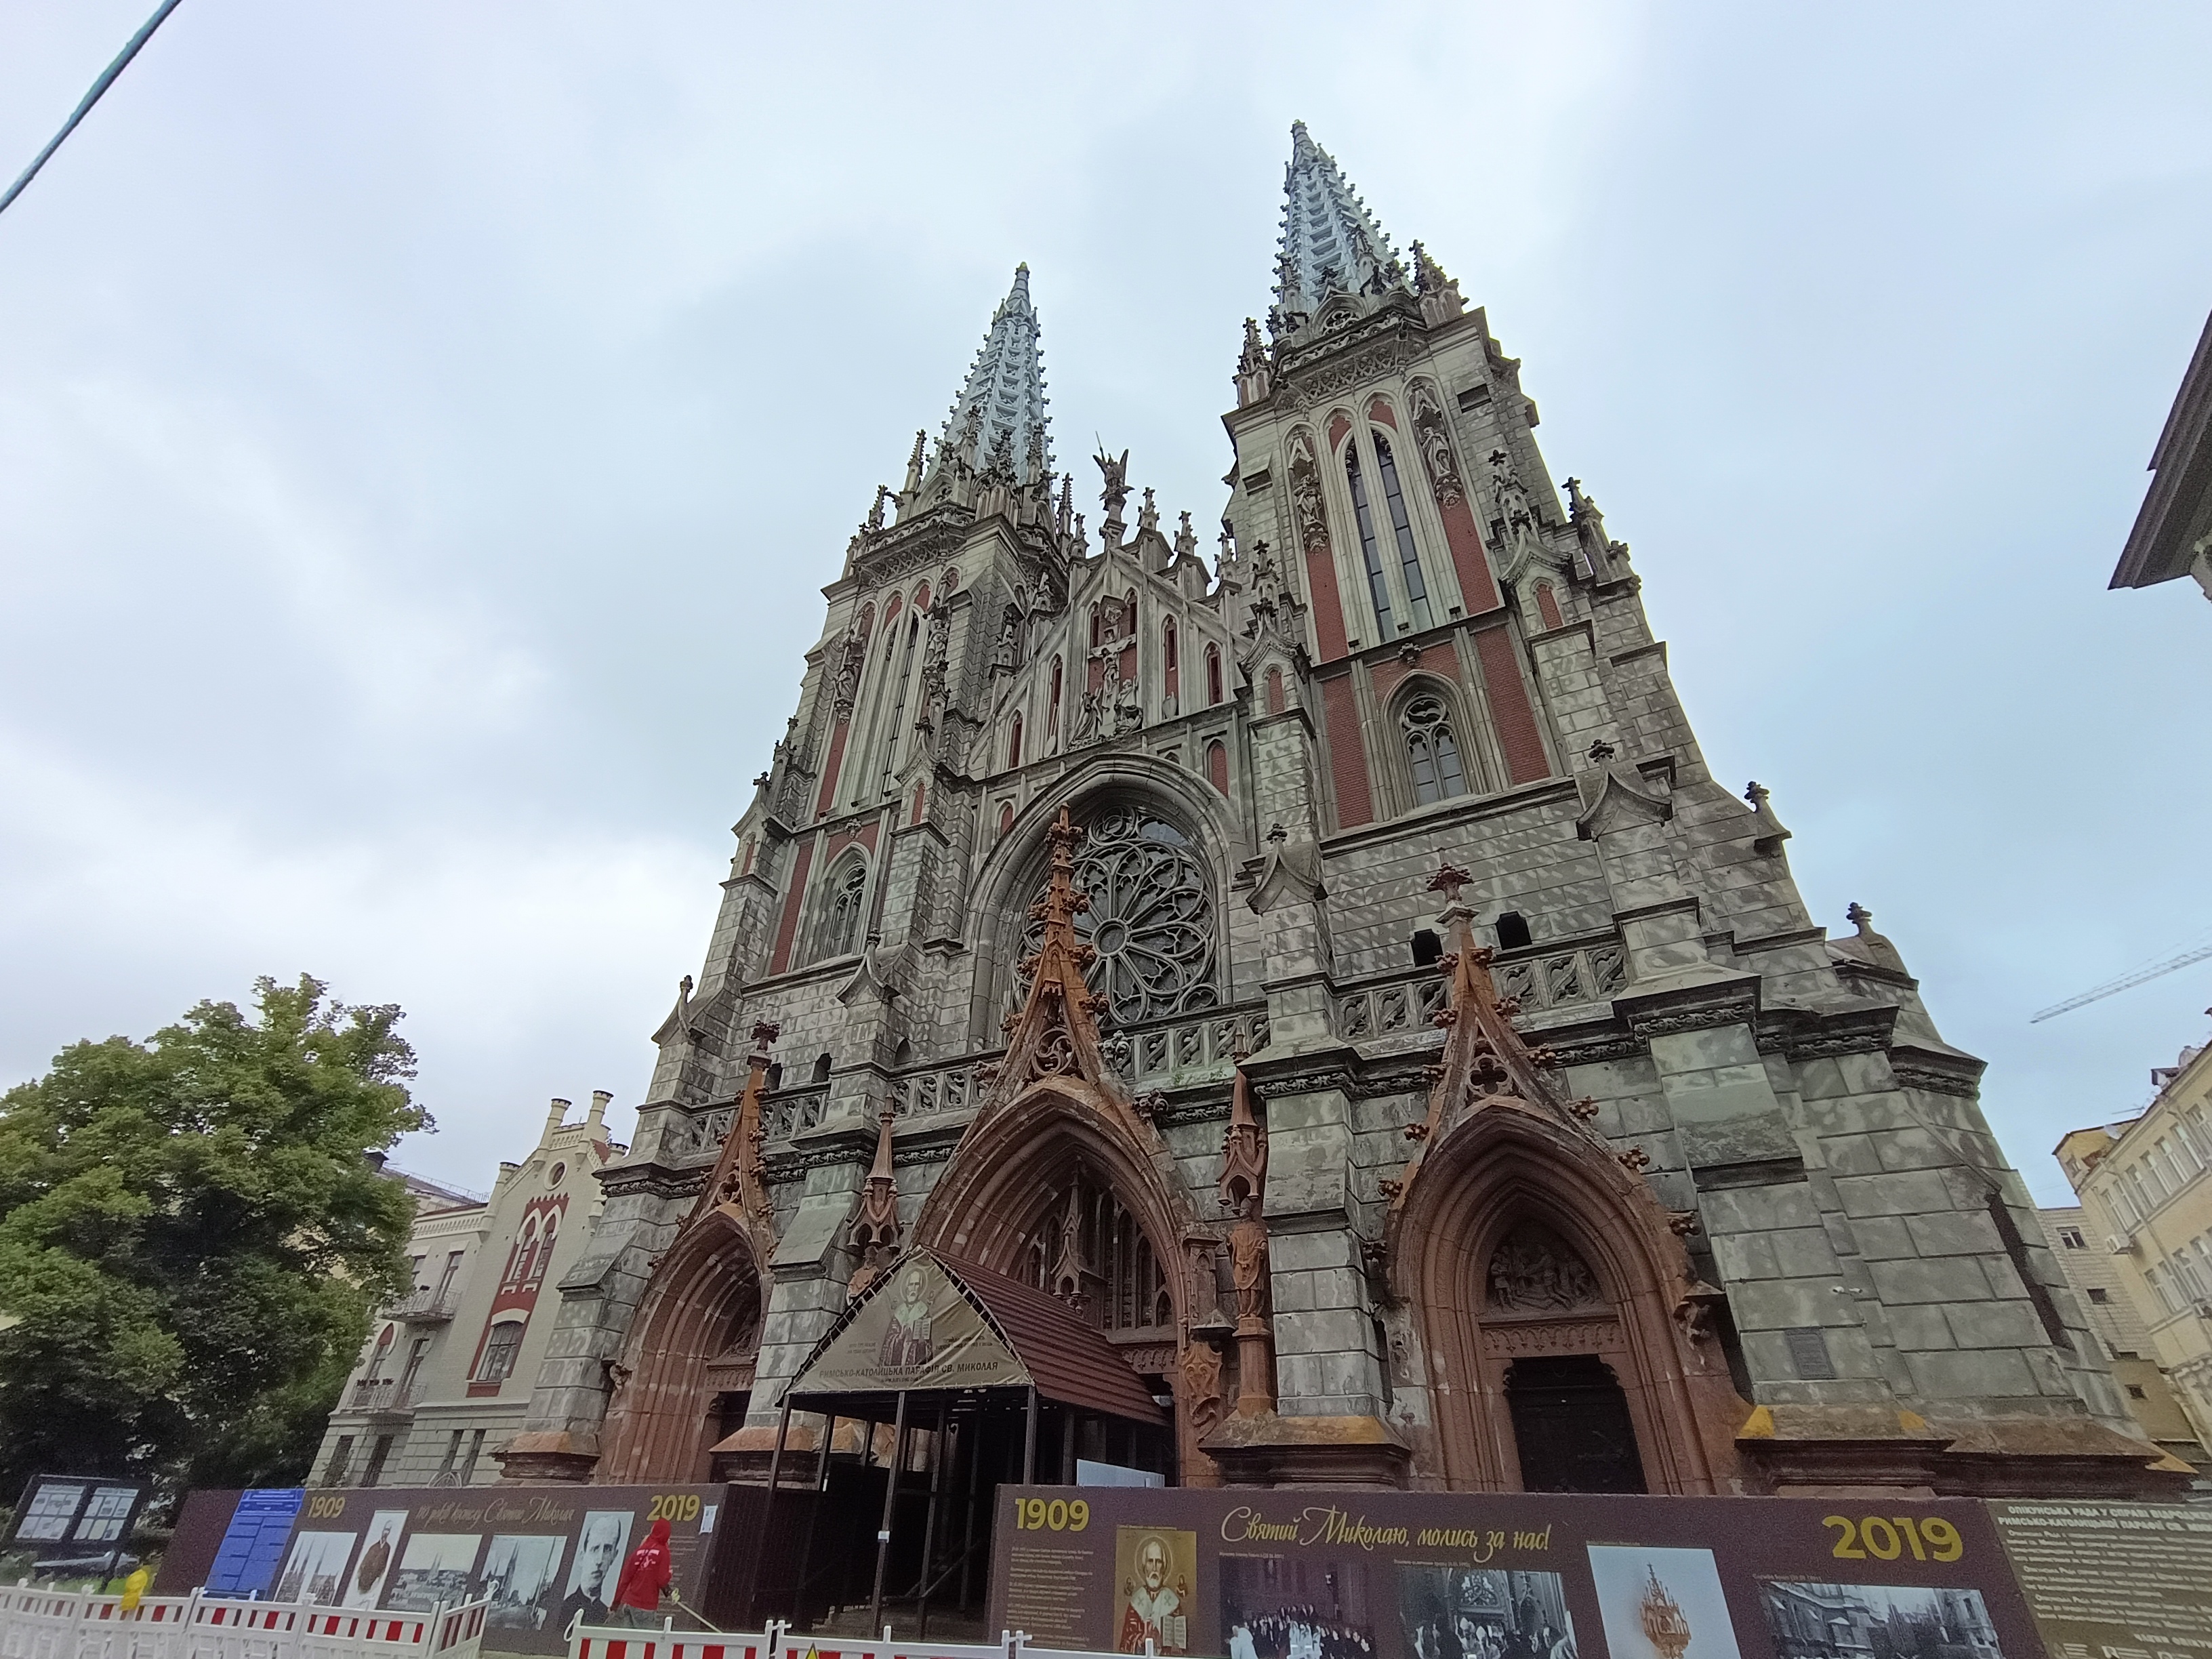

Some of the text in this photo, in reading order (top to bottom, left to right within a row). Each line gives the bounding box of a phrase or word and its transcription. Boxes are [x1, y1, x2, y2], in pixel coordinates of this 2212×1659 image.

[819, 1361, 998, 1378] РИМСЬКО-КАТОЛИЦЬКА ПАРАФІЯ СВ. МИКОЛАЯ
[308, 1496, 346, 1518] 1909
[647, 1494, 701, 1521] 2019
[1015, 1498, 1090, 1532] 1909
[2072, 1507, 2100, 1516] РАДА
[1221, 1504, 1552, 1563] Святий Миколаю, молись за нас!
[1822, 1515, 1963, 1562] 2019
